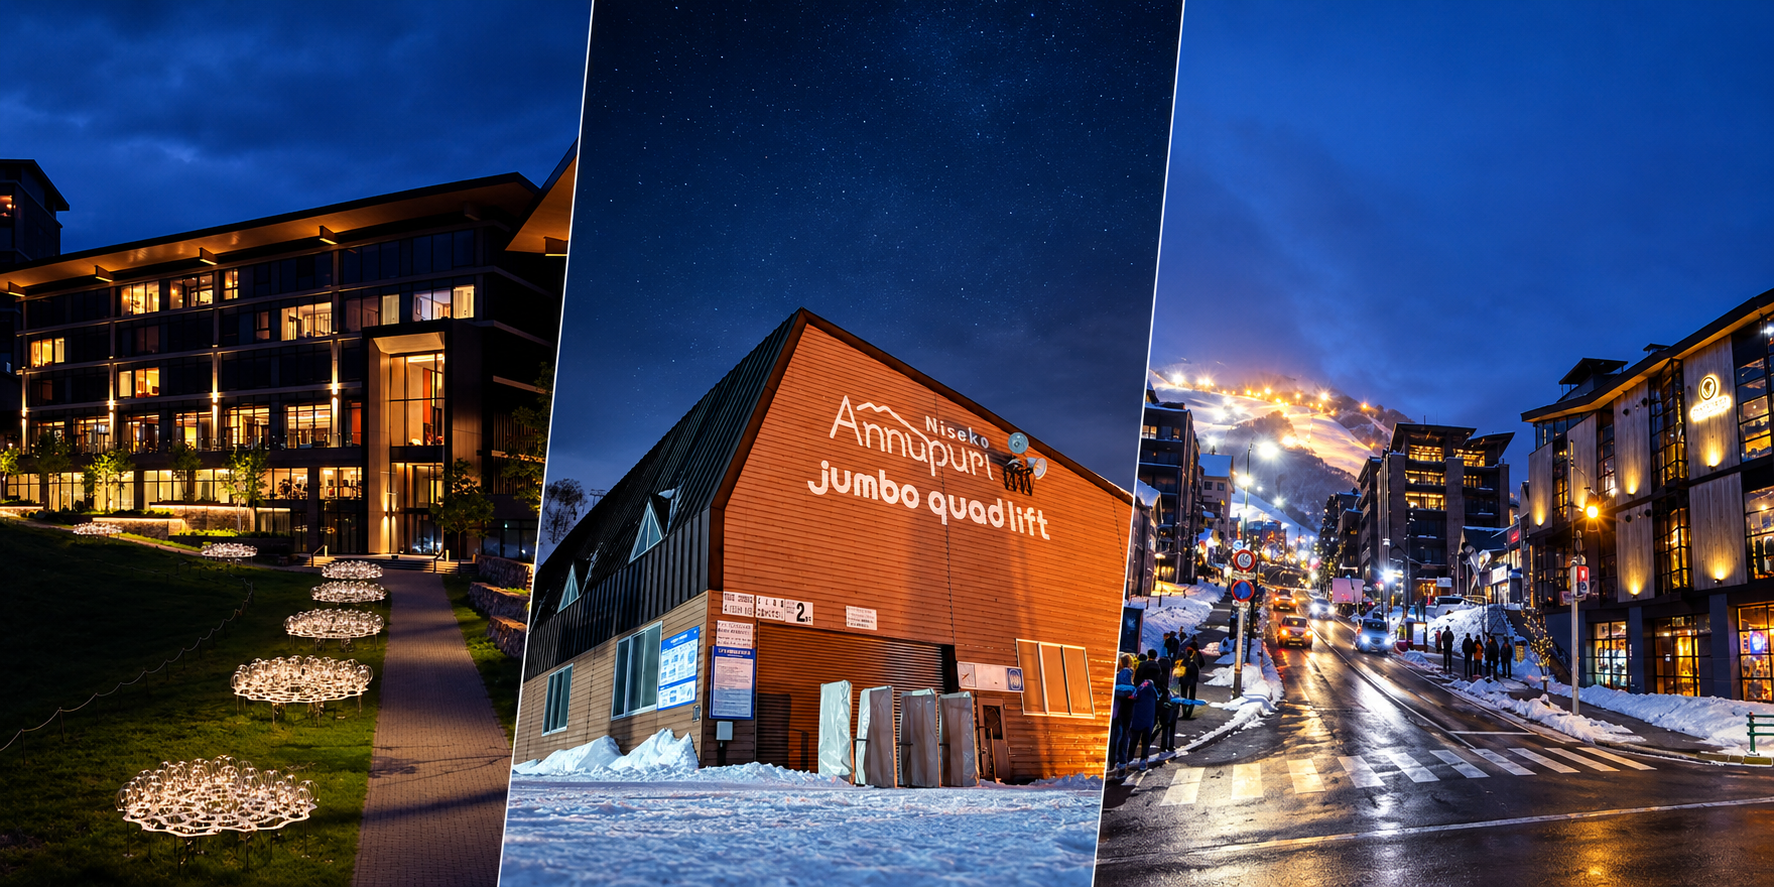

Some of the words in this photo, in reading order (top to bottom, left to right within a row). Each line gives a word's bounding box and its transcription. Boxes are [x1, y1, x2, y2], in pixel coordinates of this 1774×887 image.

[829, 395, 994, 481] Annupuri
[925, 415, 990, 450] Niseko
[807, 460, 920, 510] jumbo
[927, 490, 1005, 528] quad
[1007, 501, 1051, 541] lift
[796, 602, 806, 623] 2
